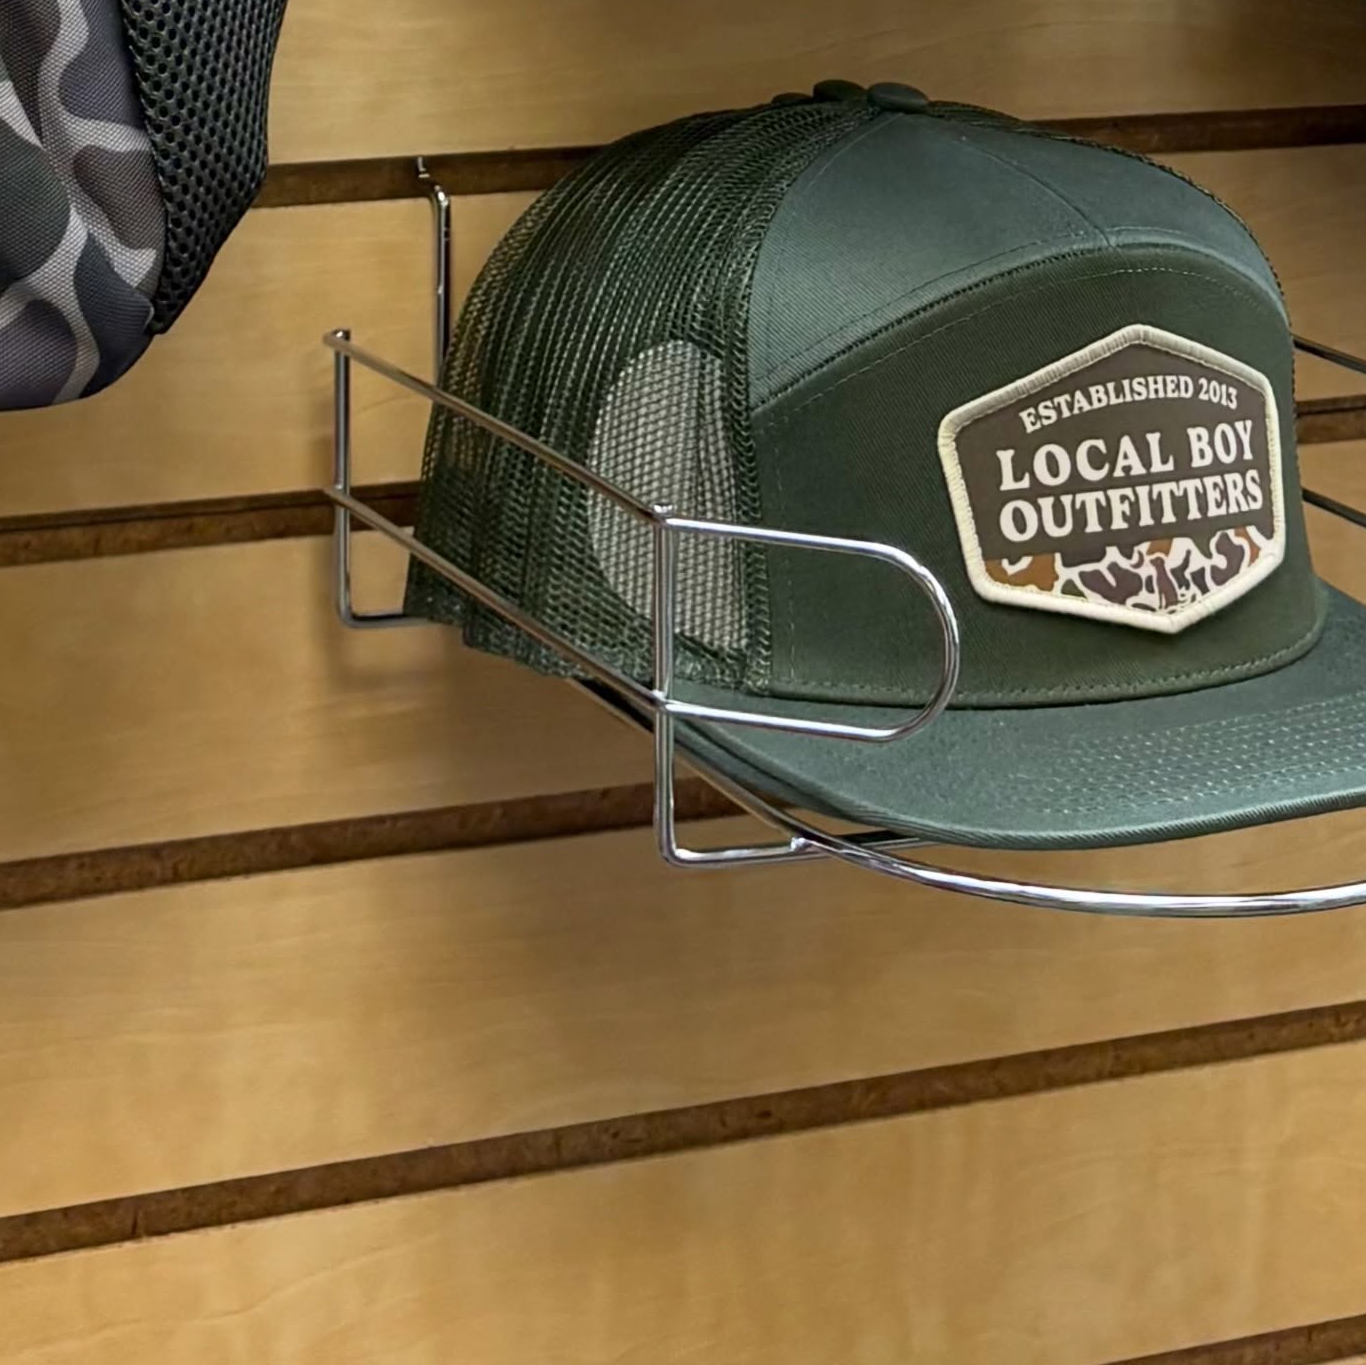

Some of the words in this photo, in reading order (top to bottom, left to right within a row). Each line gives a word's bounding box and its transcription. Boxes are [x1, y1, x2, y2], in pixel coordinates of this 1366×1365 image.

[1019, 375, 1193, 434] ESTABLISHED
[1198, 378, 1238, 410] 2013
[996, 431, 1175, 491] LOCAL
[1186, 420, 1254, 469] BOY
[999, 469, 1263, 543] OUTFITTERS
